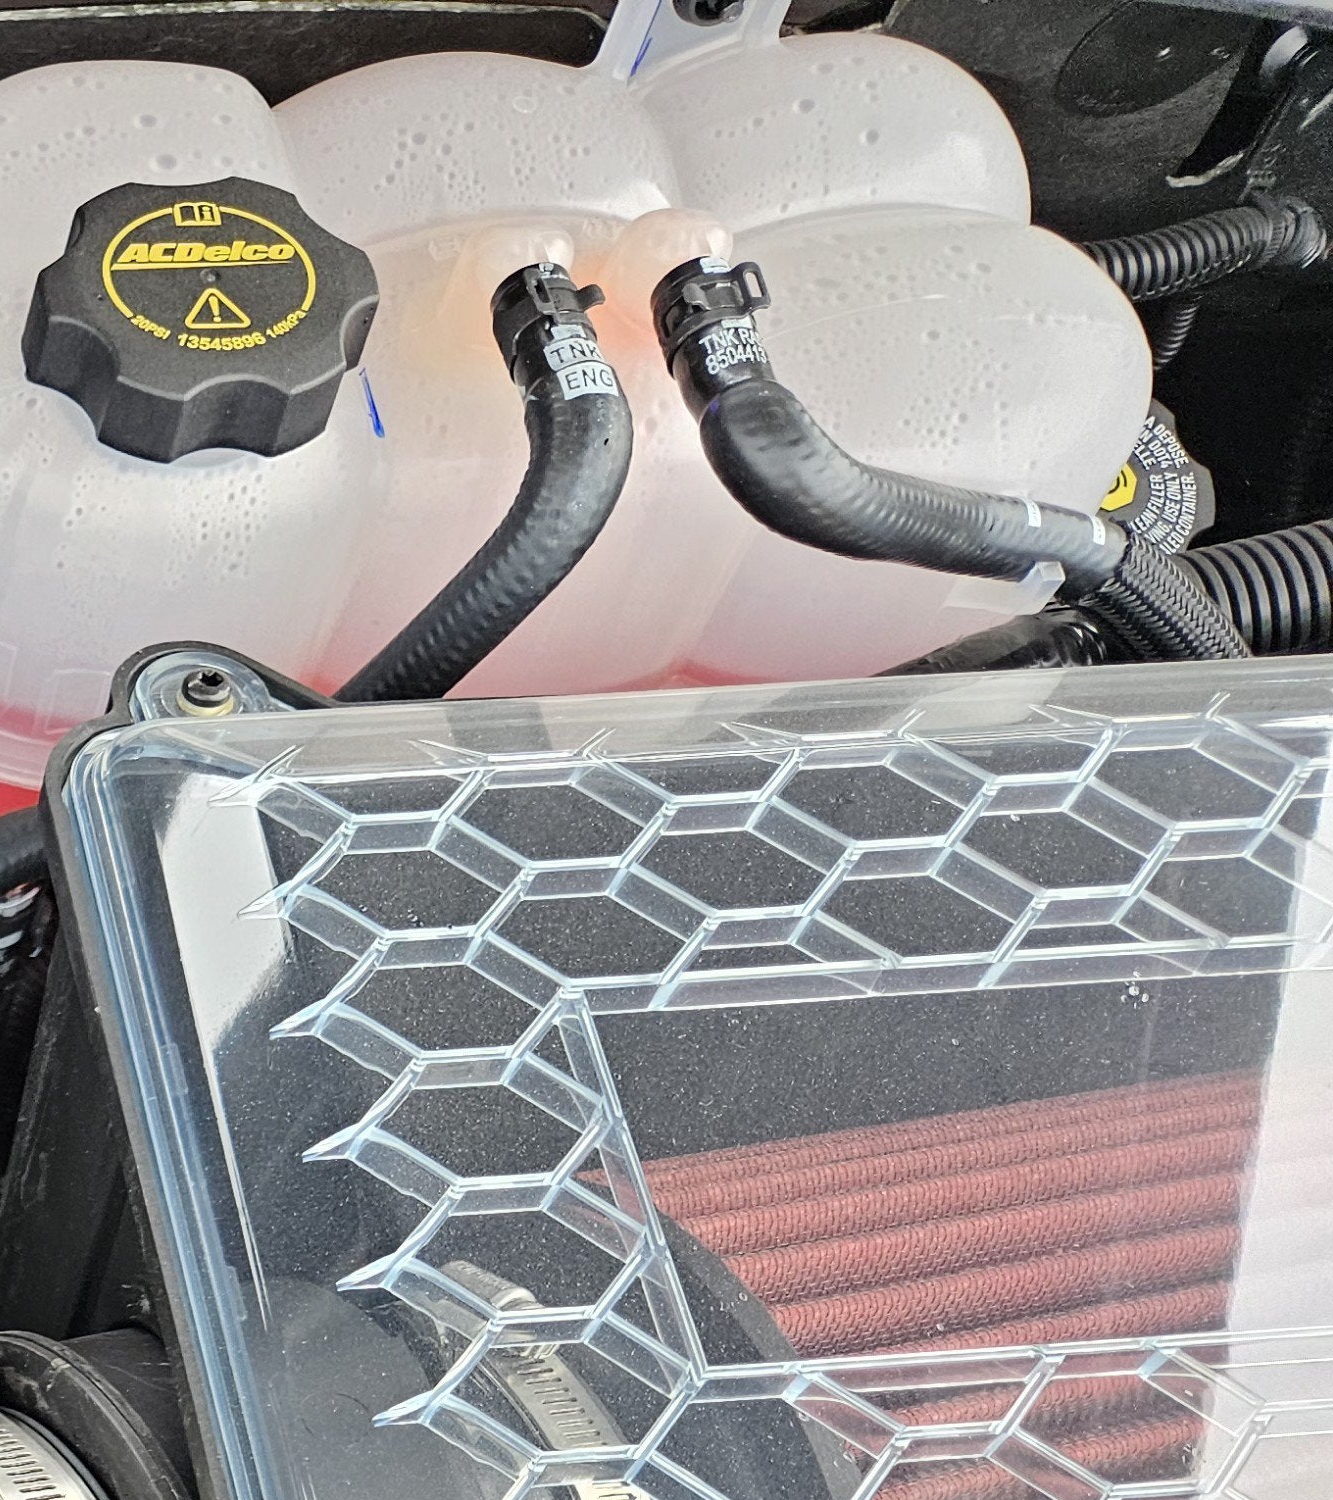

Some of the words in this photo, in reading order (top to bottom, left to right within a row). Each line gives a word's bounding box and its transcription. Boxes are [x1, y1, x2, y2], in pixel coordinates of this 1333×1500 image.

[116, 240, 296, 264] ACDelco
[130, 314, 172, 340] 20PSI
[177, 331, 268, 351] 13545896
[698, 328, 740, 354] TNK
[737, 328, 764, 346] RA
[549, 340, 602, 364] TNK
[564, 368, 614, 391] ENG
[1164, 472, 1182, 502] ONLY
[1130, 509, 1159, 534] LEAN
[1149, 474, 1166, 514] FILLER
[1162, 499, 1181, 523] USE
[1144, 520, 1173, 545] VING.
